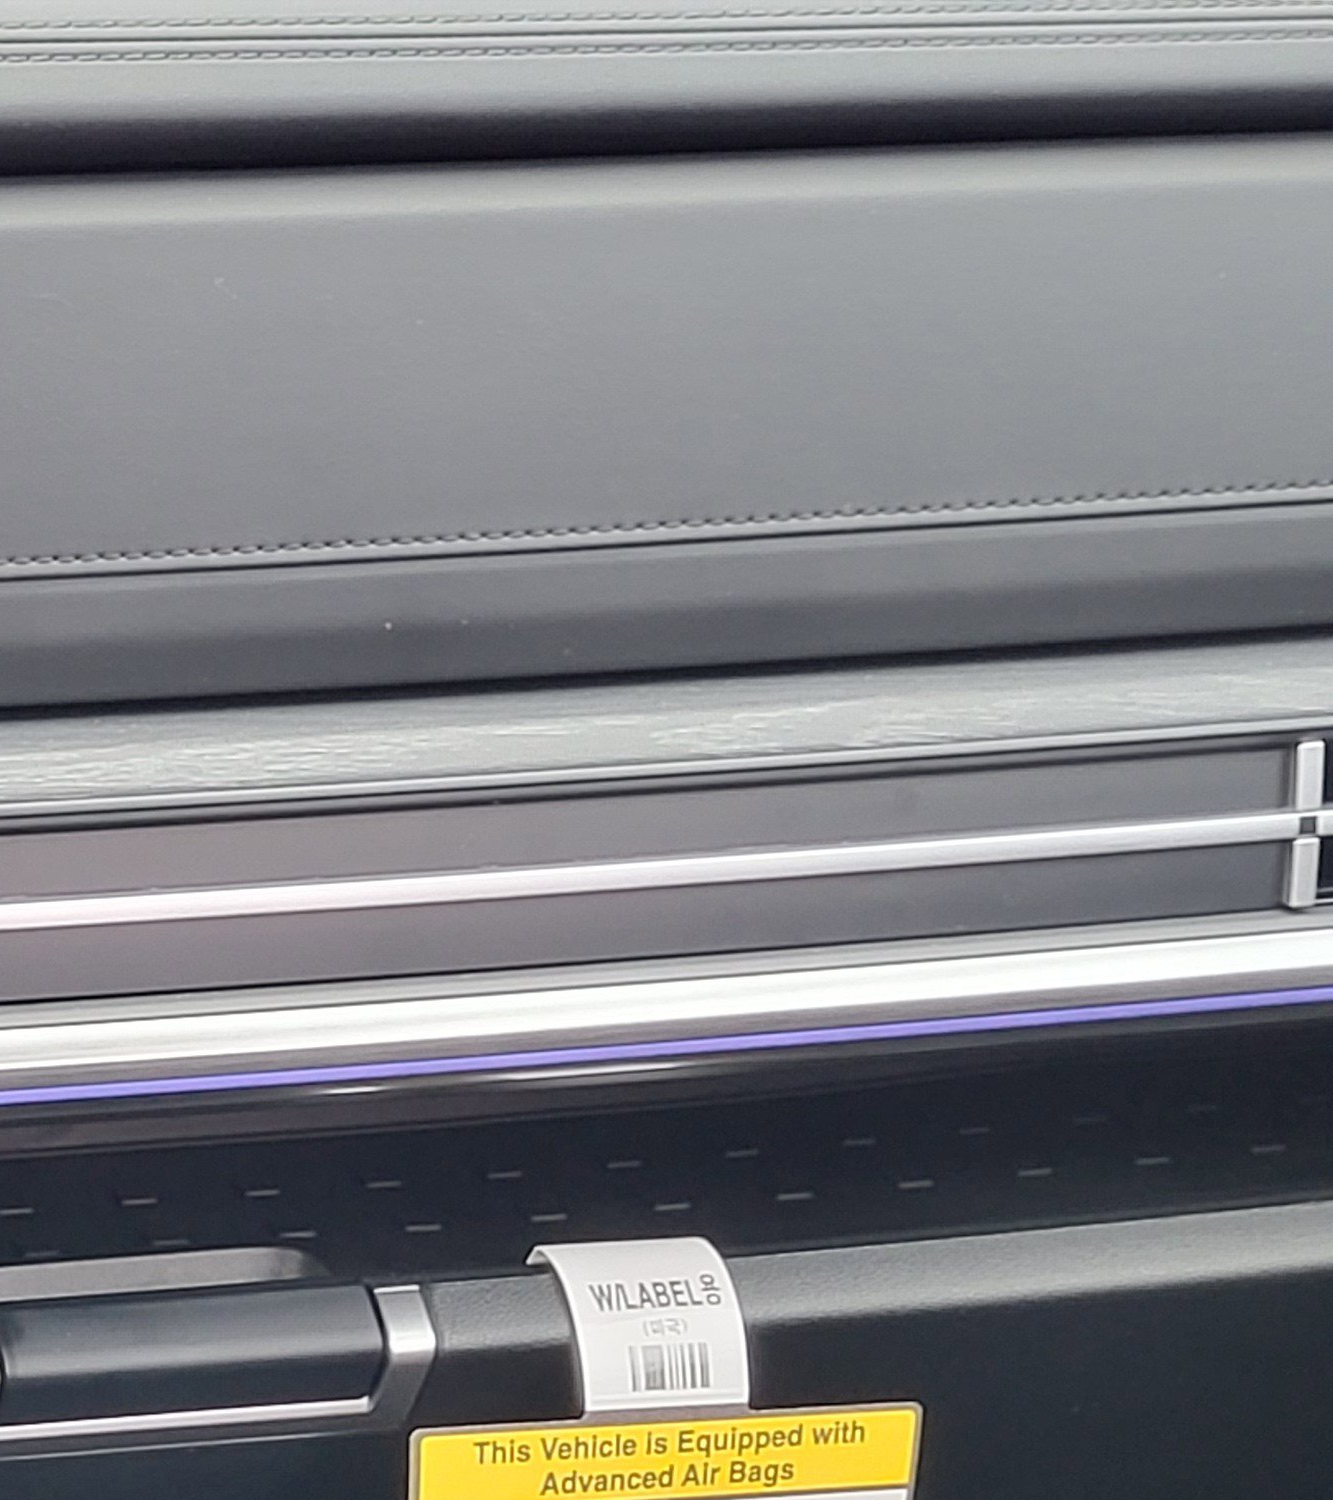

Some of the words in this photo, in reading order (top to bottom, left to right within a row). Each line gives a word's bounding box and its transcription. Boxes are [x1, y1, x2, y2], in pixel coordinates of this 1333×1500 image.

[474, 1439, 531, 1464] This
[540, 1434, 637, 1461] Vehicle
[646, 1431, 668, 1454] is
[678, 1424, 803, 1458] Equipped
[812, 1420, 865, 1446] with
[540, 1464, 674, 1496] Advanced
[680, 1463, 721, 1487] Air
[729, 1461, 794, 1487] Bags
